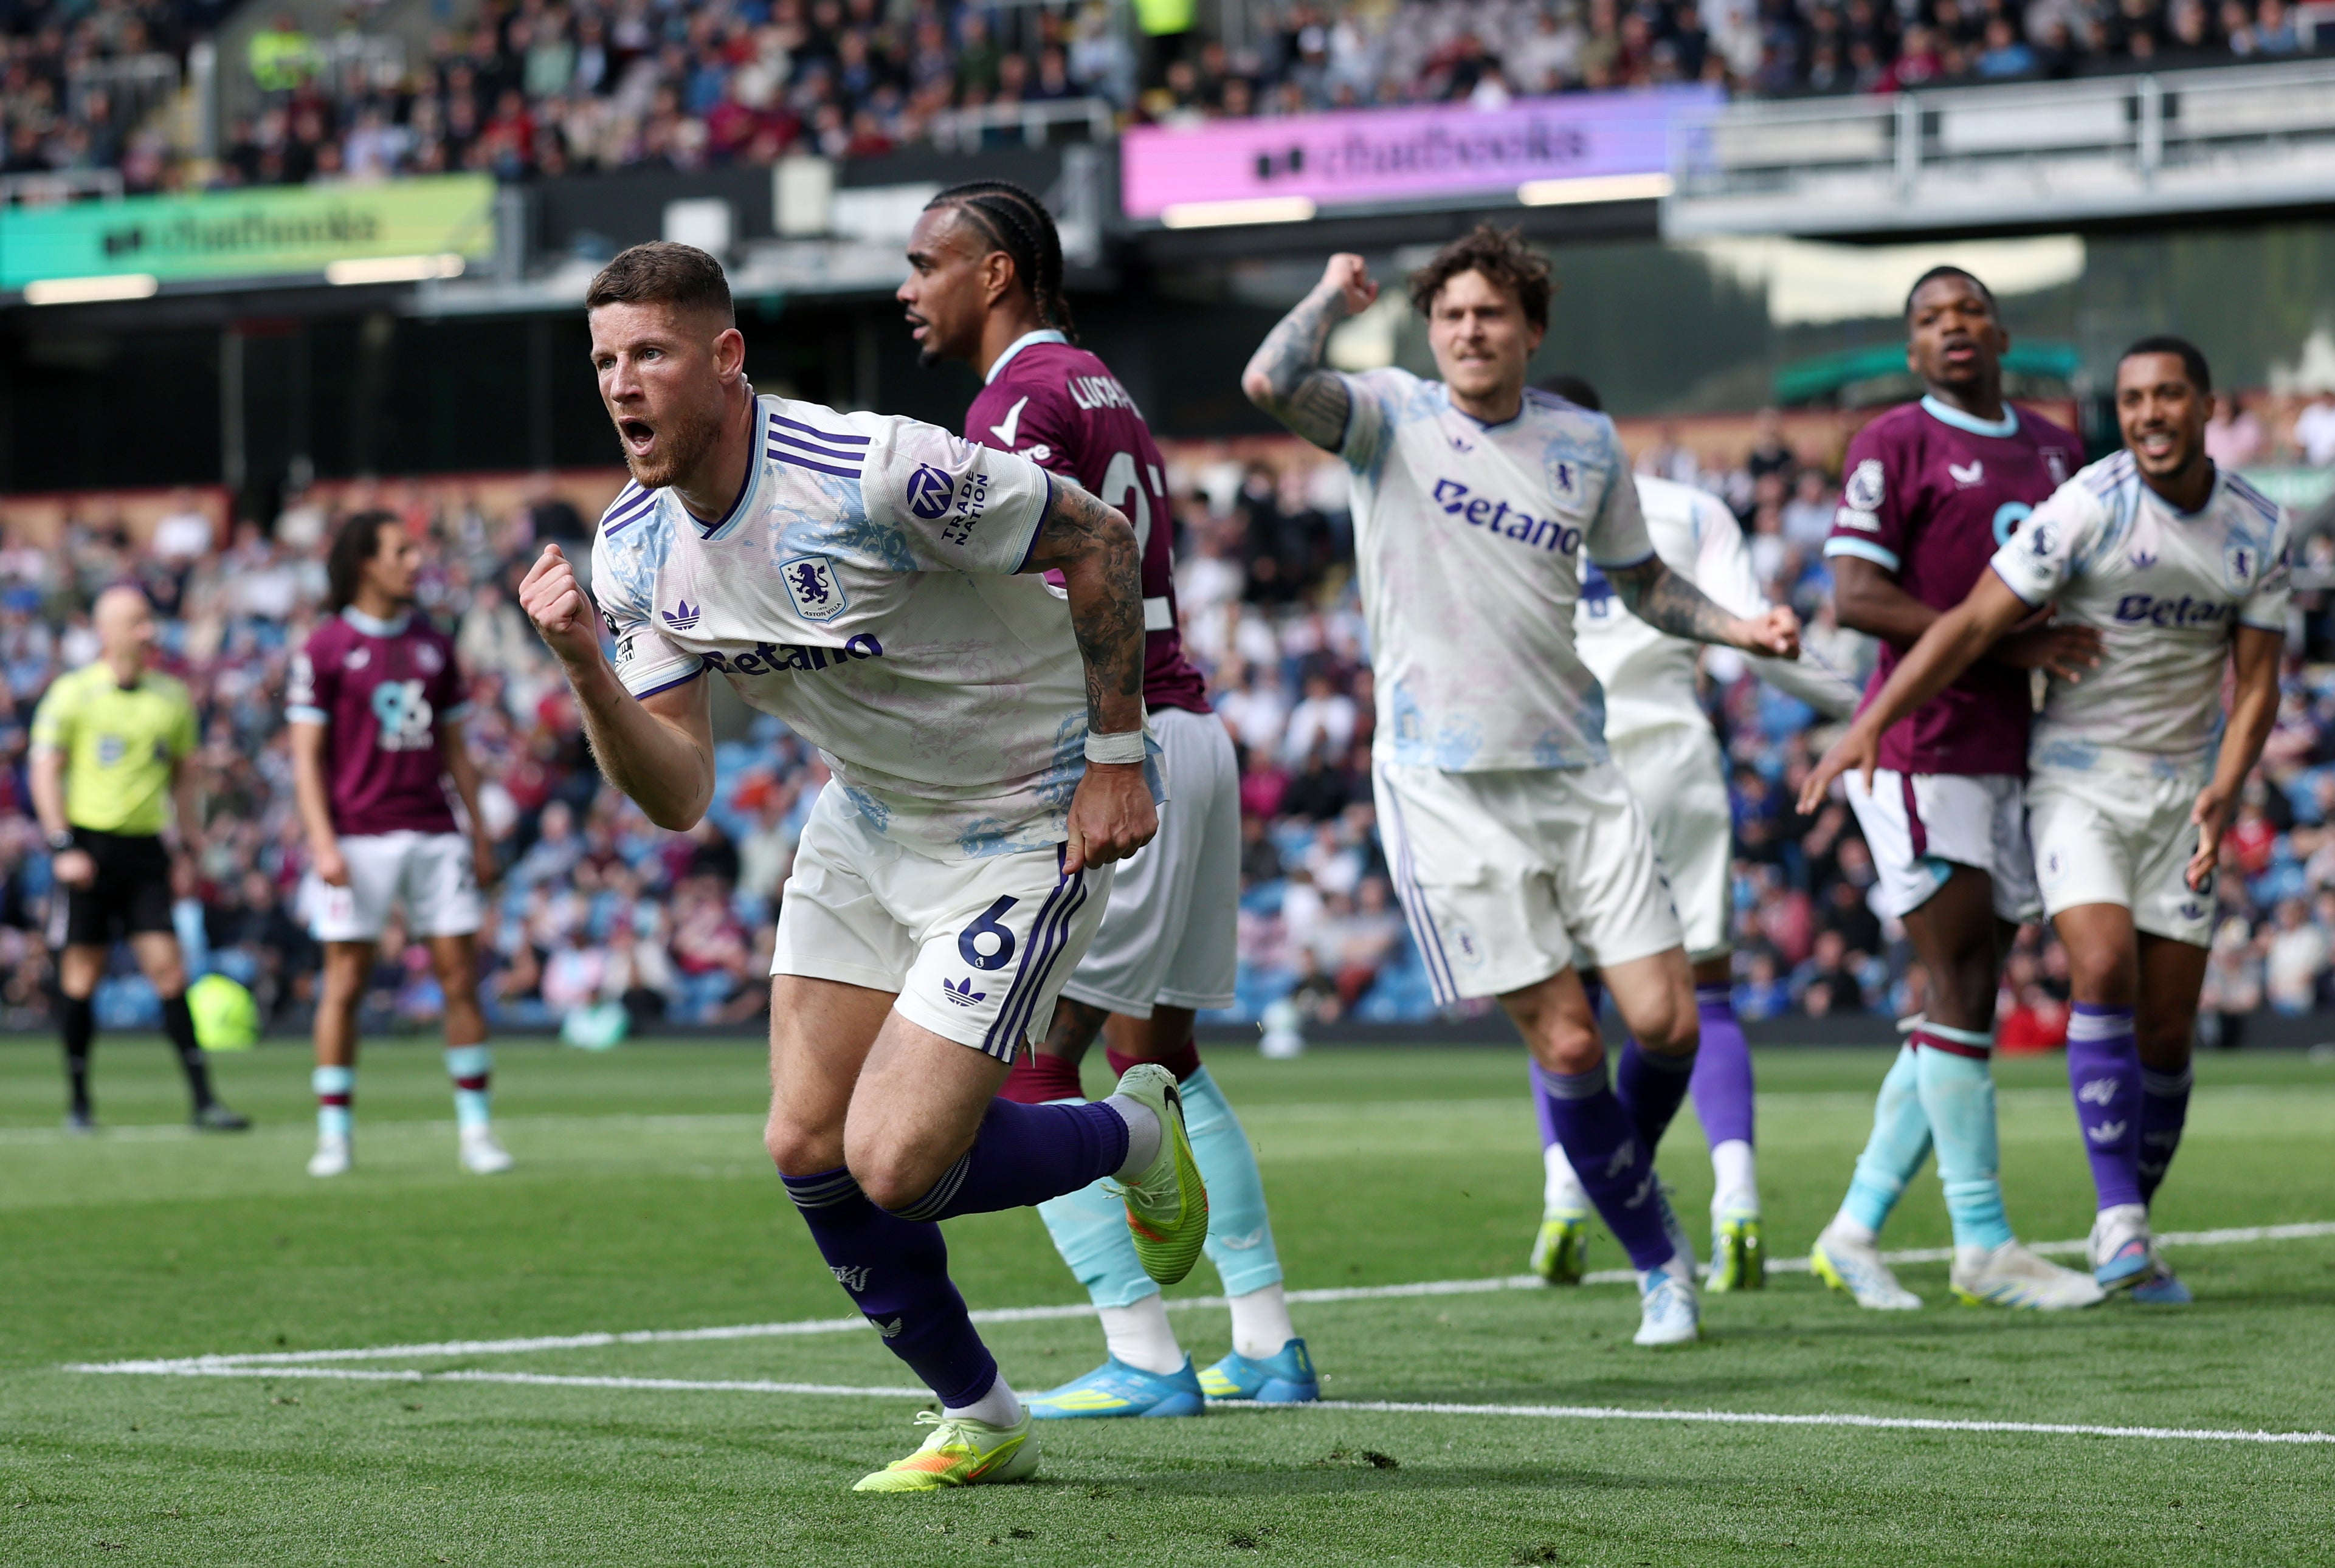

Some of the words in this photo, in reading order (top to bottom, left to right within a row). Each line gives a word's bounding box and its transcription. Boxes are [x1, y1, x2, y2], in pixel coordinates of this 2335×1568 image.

[941, 470, 974, 540] TRADE
[954, 474, 988, 546] NATION
[1433, 478, 1581, 555] Betano
[826, 603, 841, 614] VILLA
[957, 894, 1020, 971] 6
